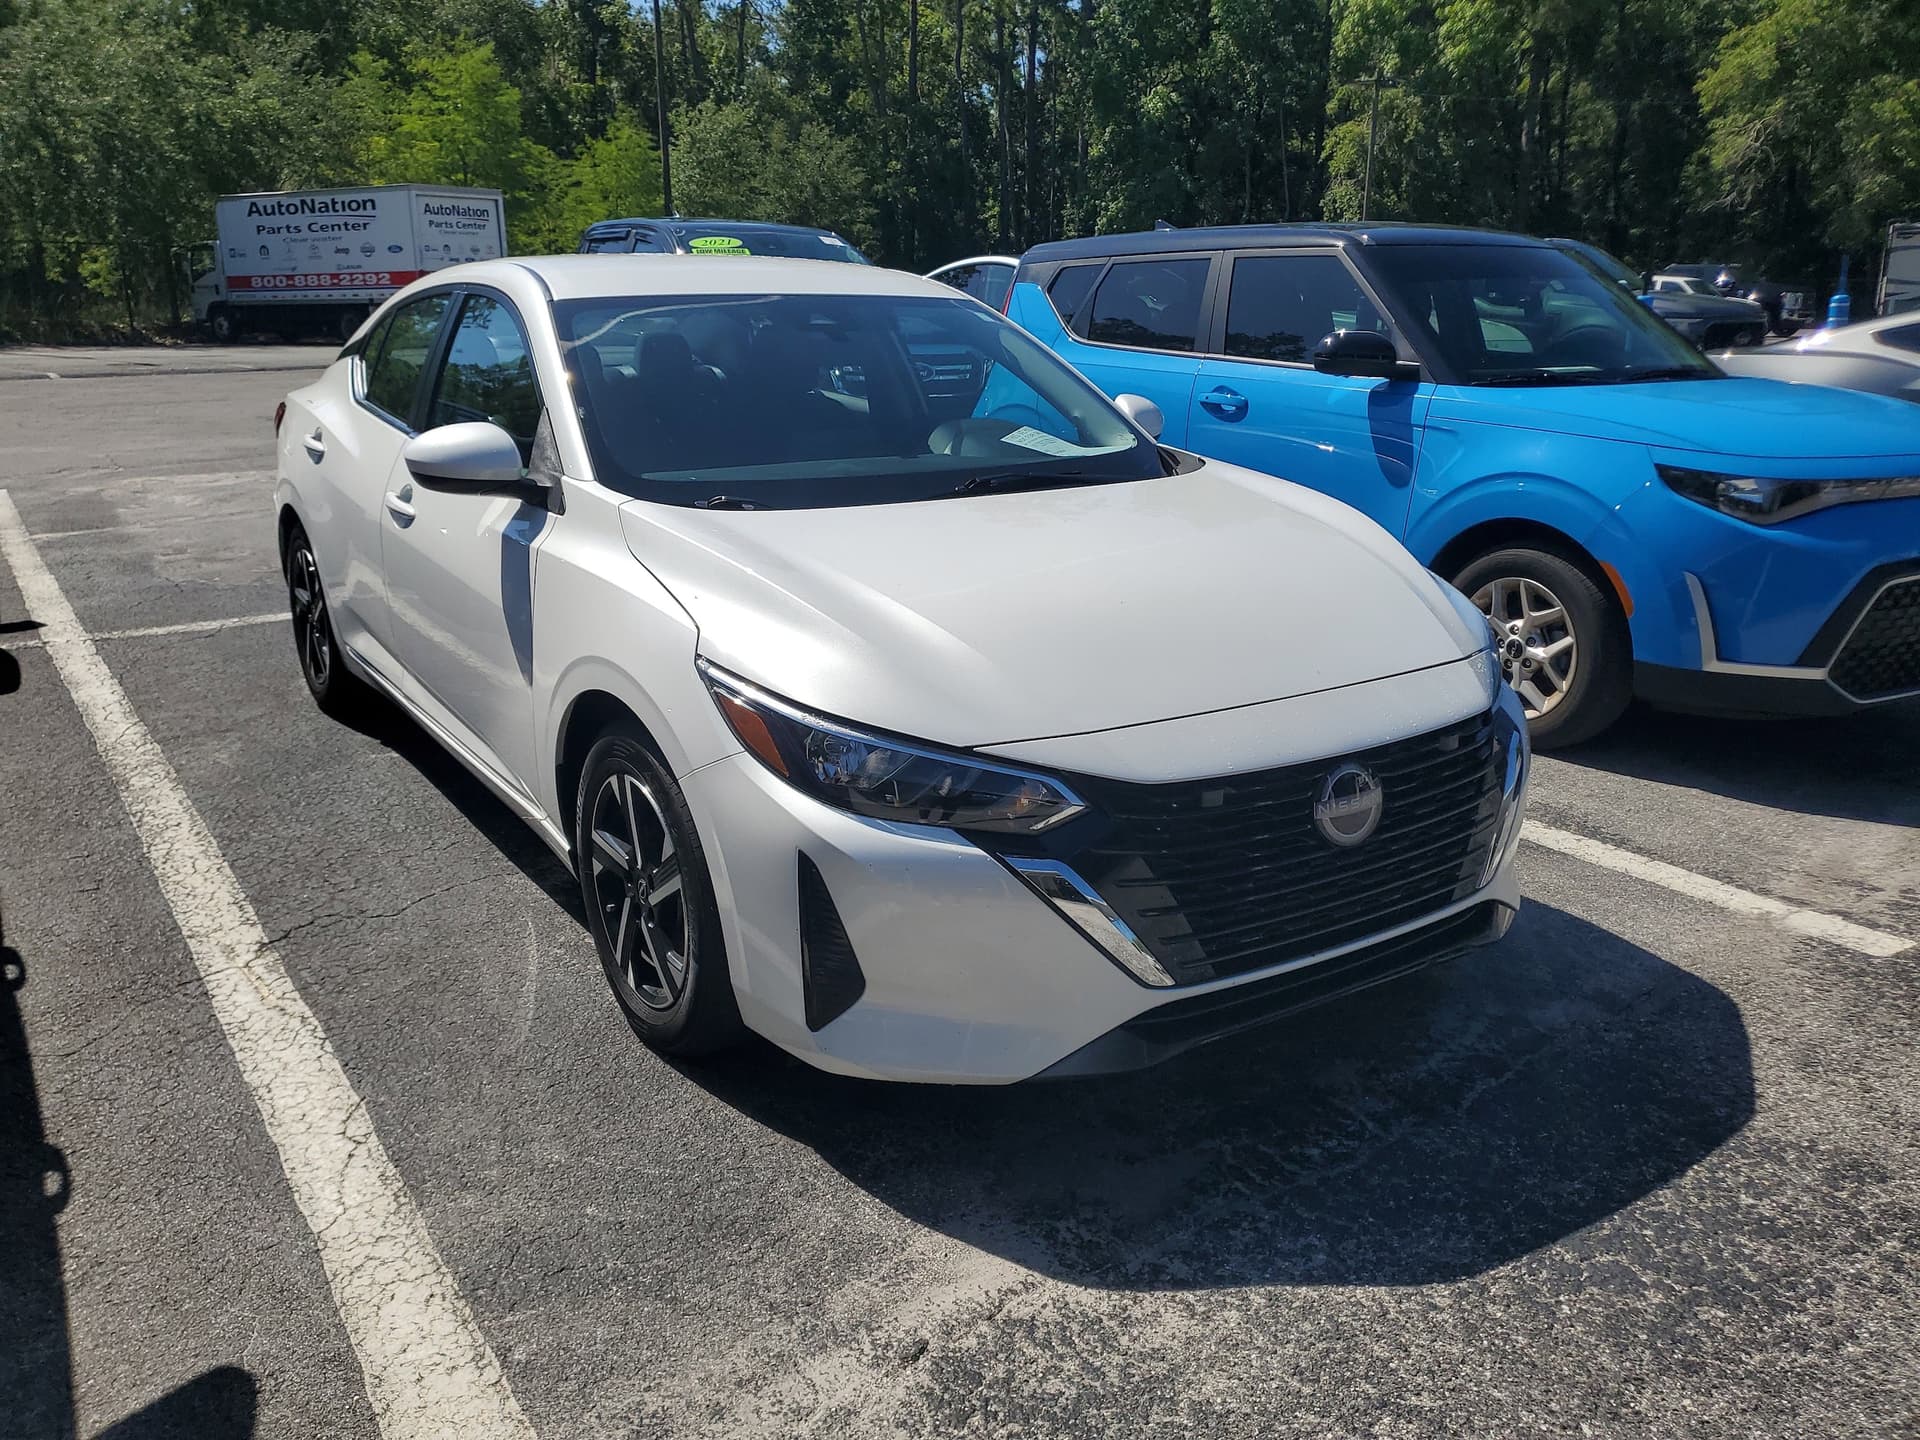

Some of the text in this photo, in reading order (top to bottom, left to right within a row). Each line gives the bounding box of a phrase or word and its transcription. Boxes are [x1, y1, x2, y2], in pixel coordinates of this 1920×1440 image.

[247, 197, 377, 217] AutoNation
[424, 203, 490, 218] AutoNation
[256, 220, 371, 235] Parts Center
[428, 220, 487, 230] Parts Center
[251, 273, 392, 288] 800-888-2292
